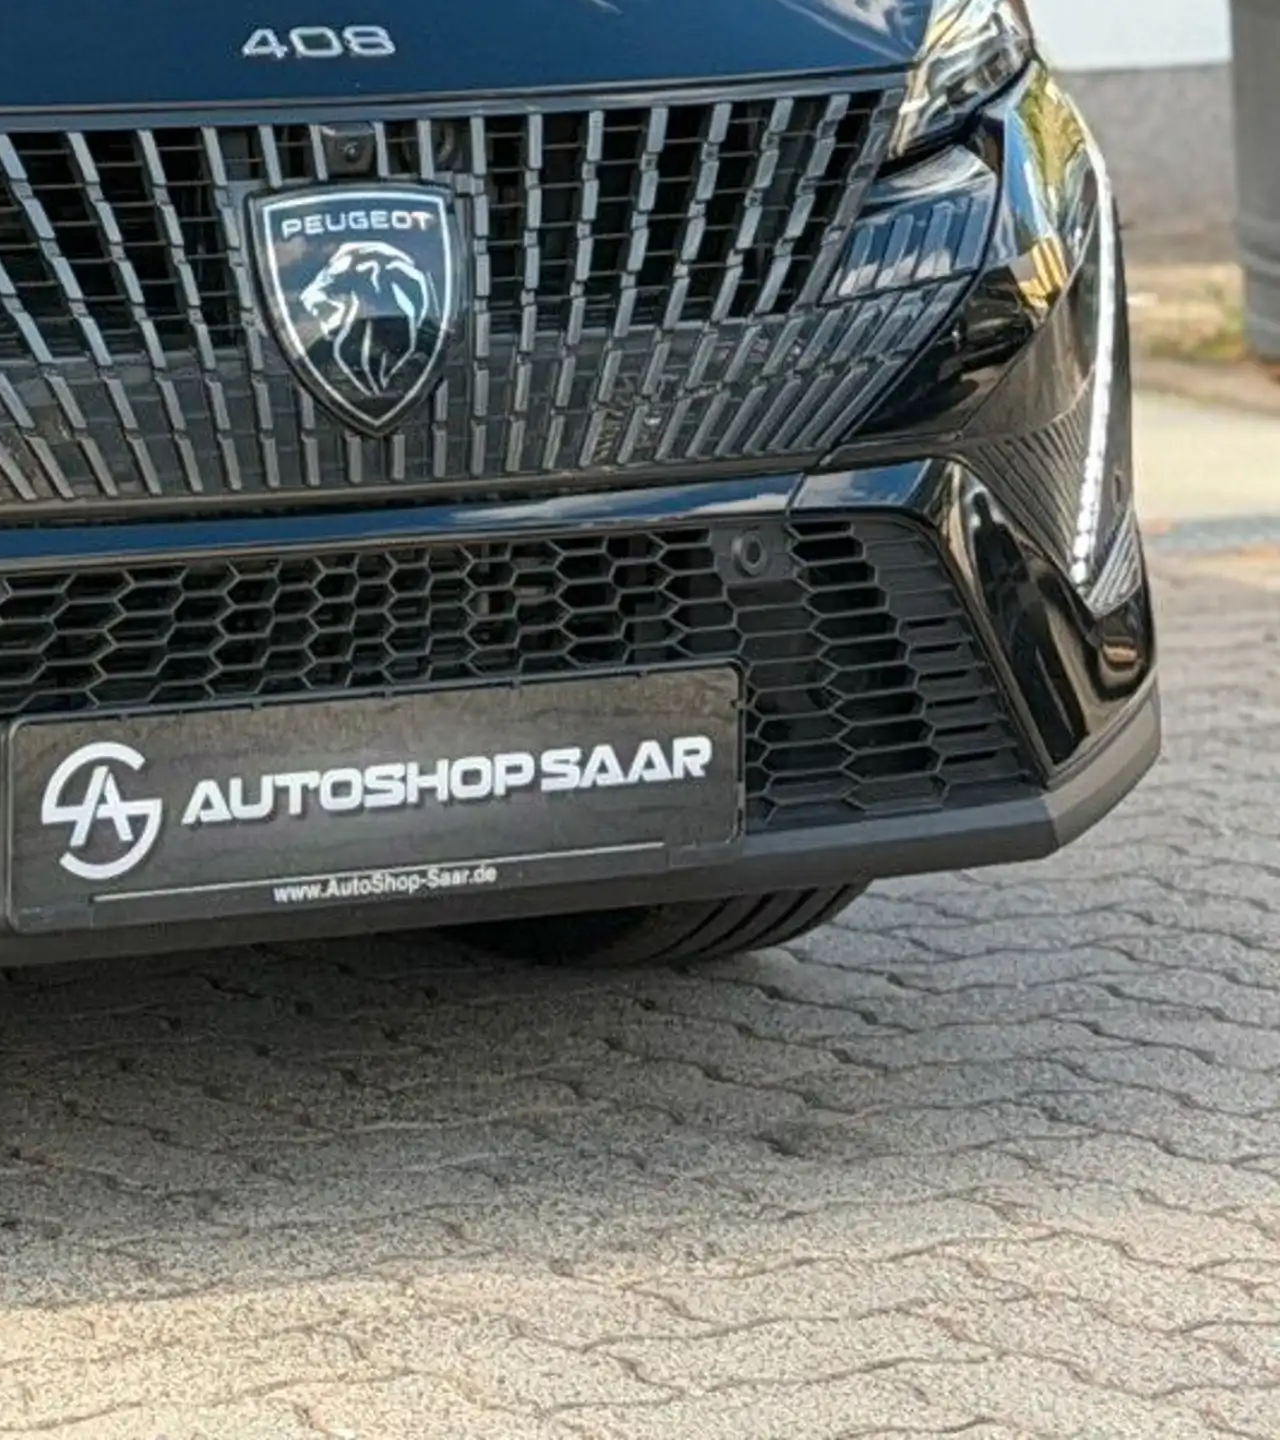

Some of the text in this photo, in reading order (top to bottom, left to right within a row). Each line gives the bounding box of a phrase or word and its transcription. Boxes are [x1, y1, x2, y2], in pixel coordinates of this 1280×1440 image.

[242, 25, 396, 58] 408
[281, 210, 433, 238] PEUGEOT
[273, 864, 498, 903] www.AutoShop-Saar.de
